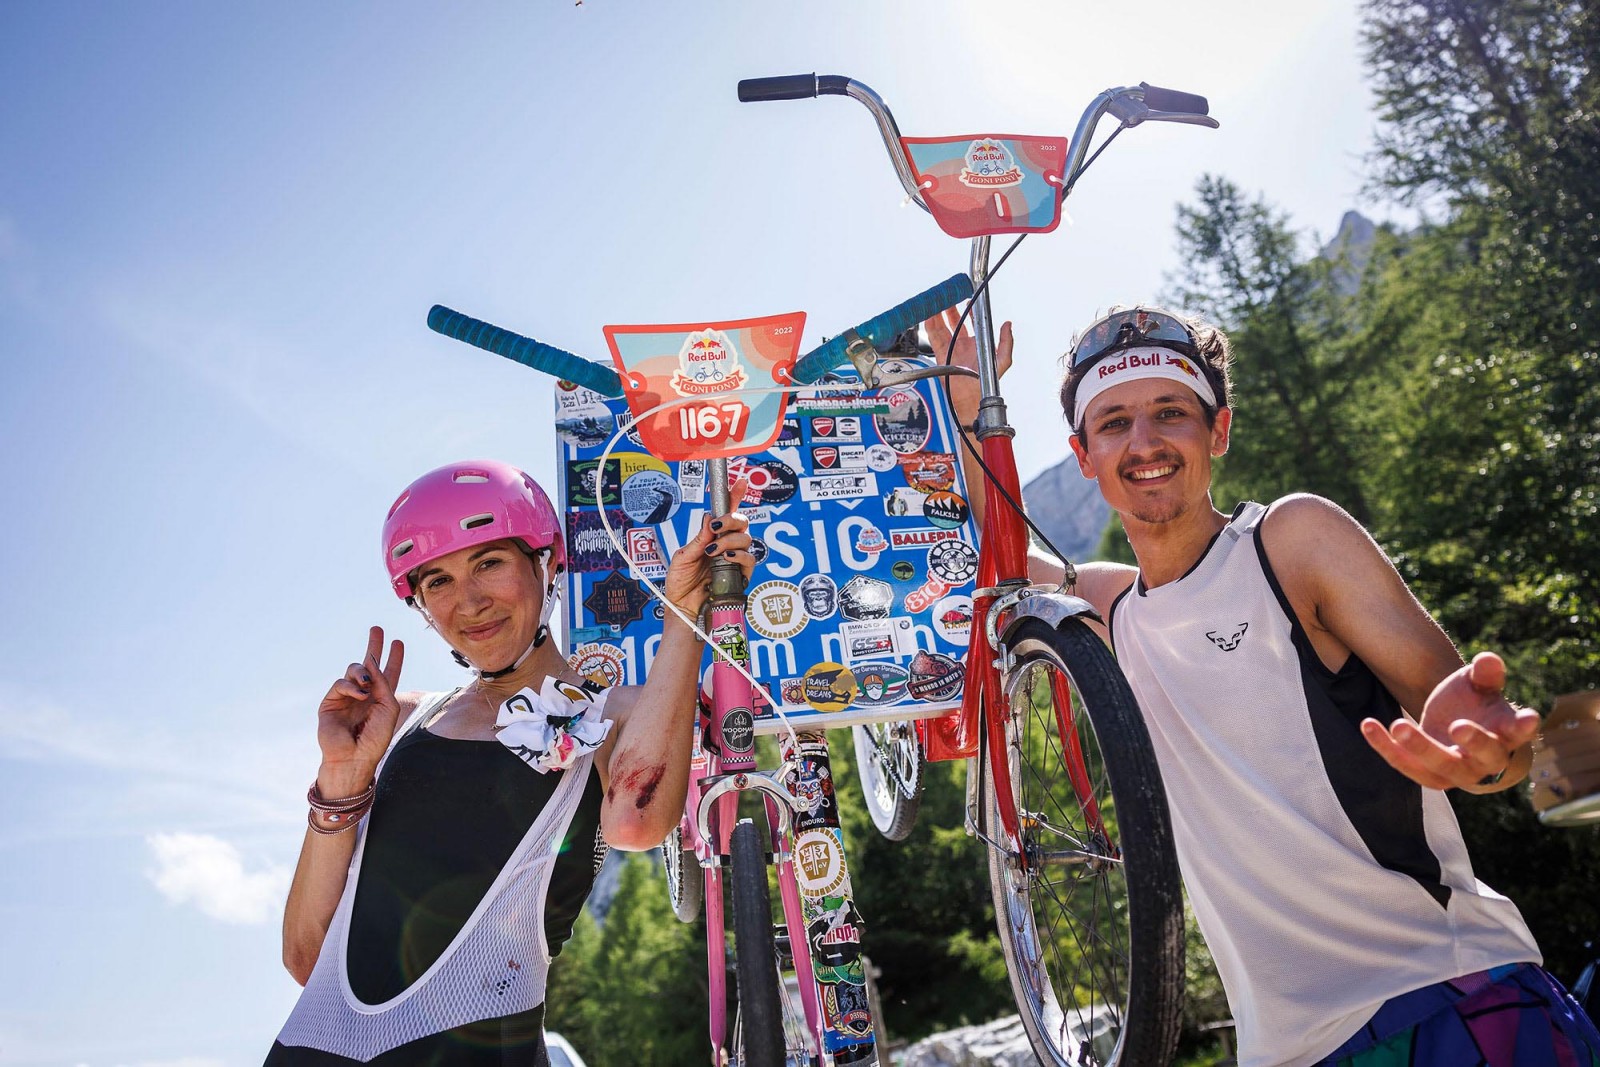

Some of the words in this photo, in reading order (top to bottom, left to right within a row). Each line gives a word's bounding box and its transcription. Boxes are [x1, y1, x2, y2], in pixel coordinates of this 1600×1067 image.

[972, 154, 989, 162] Red
[989, 153, 1005, 161] Bull
[970, 176, 993, 184] GONI
[994, 174, 1017, 183] PONY
[774, 326, 793, 336] 2022
[687, 352, 707, 362] Red
[708, 350, 727, 361] Bull
[1098, 356, 1128, 379] Red
[1129, 353, 1160, 368] Bull
[683, 384, 711, 394] GONI
[711, 380, 737, 393] PONY
[679, 403, 744, 440] 1167
[625, 462, 650, 473] hier.
[832, 488, 863, 496] CERKNO
[659, 499, 882, 579] Všič
[579, 644, 599, 656] BEER
[602, 644, 626, 659] CREW
[749, 638, 798, 678] m
[806, 678, 831, 687] TRAVEL
[800, 818, 825, 828] ENDURO
